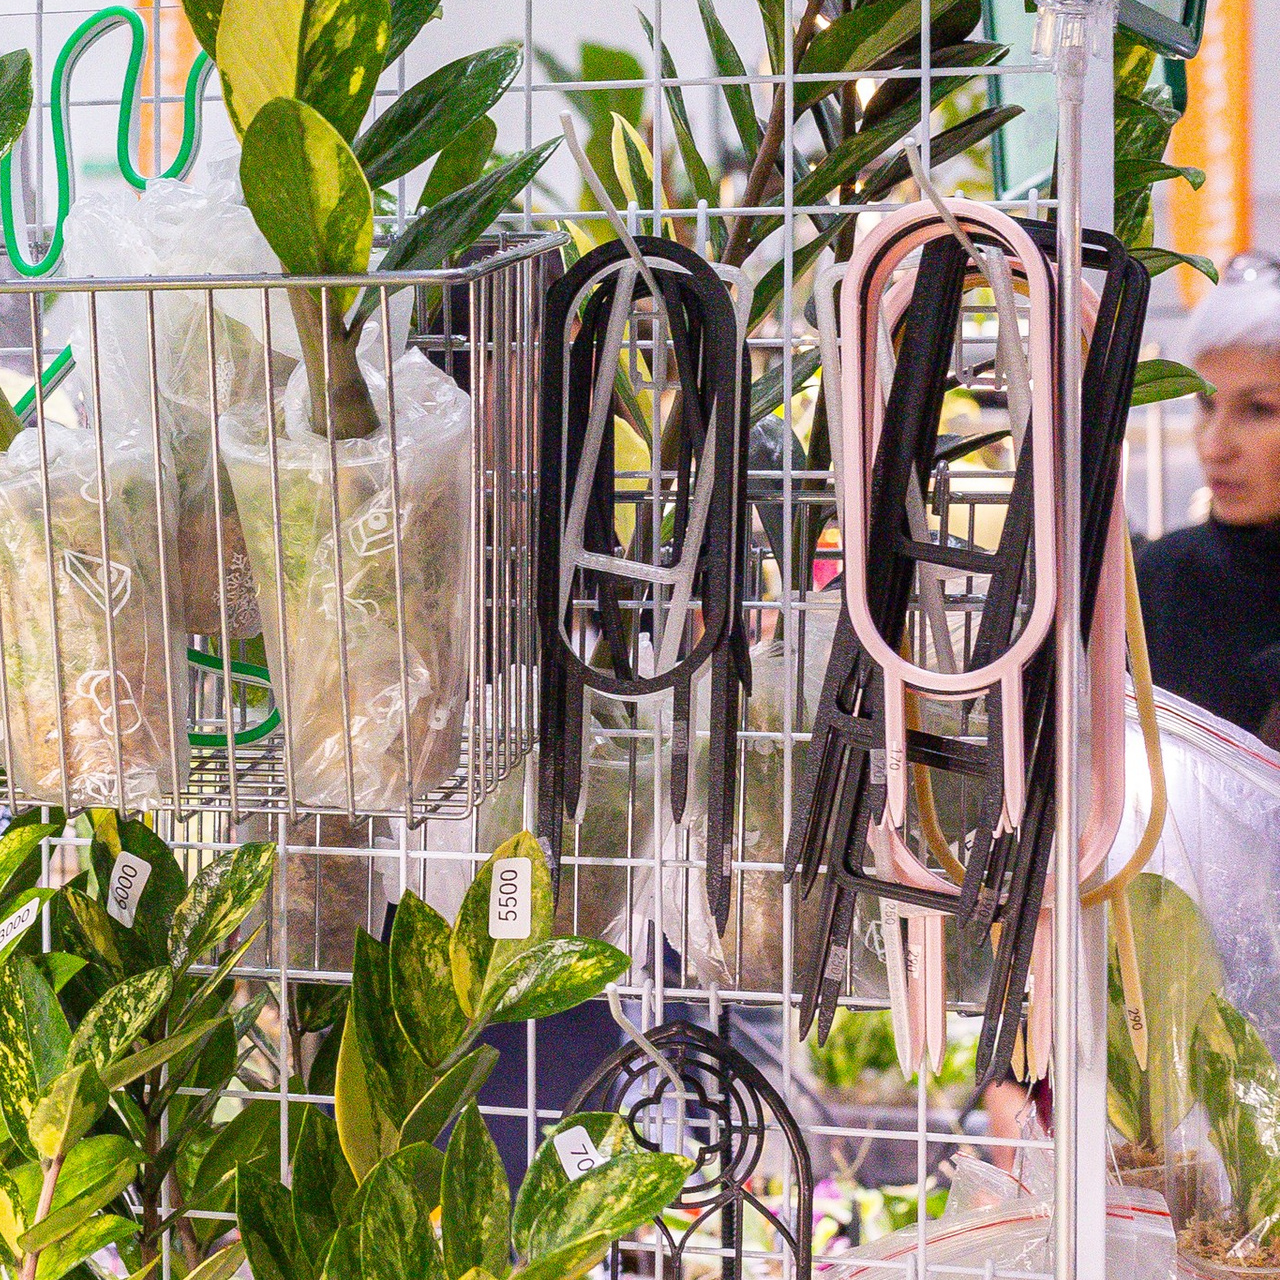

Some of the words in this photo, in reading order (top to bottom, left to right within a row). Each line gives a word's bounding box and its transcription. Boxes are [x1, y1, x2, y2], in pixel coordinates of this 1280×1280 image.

[890, 748, 902, 771] 170
[113, 864, 138, 911] 6000
[498, 869, 518, 922] 5500
[885, 902, 897, 926] 250
[1128, 1007, 1144, 1031] 290
[570, 1143, 595, 1172] 70
